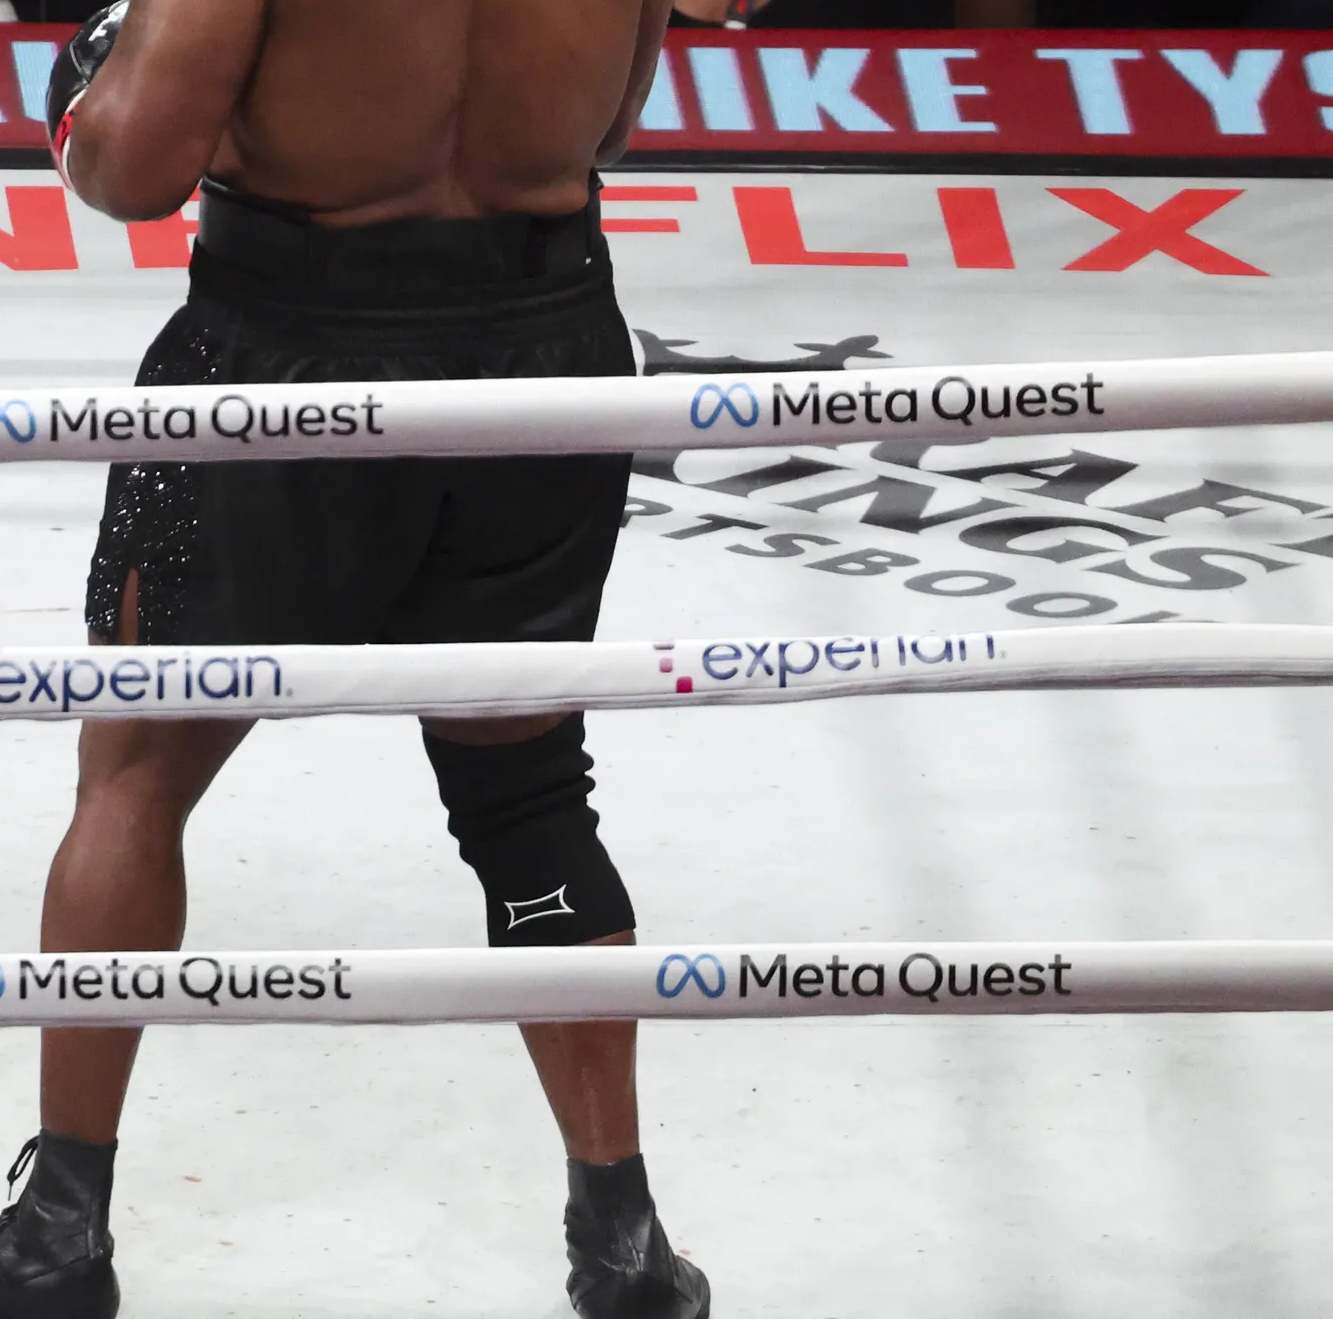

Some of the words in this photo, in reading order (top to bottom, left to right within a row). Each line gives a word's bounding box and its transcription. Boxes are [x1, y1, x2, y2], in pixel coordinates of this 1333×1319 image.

[50, 398, 197, 442] Meta
[211, 387, 383, 442] Quest
[773, 381, 917, 426] Meta
[932, 373, 1105, 426] Quest
[632, 449, 1303, 589] INGS
[19, 958, 164, 1000] Meta
[178, 953, 351, 1007] Quest
[739, 954, 884, 998] Meta
[899, 952, 1072, 1000] Quest
